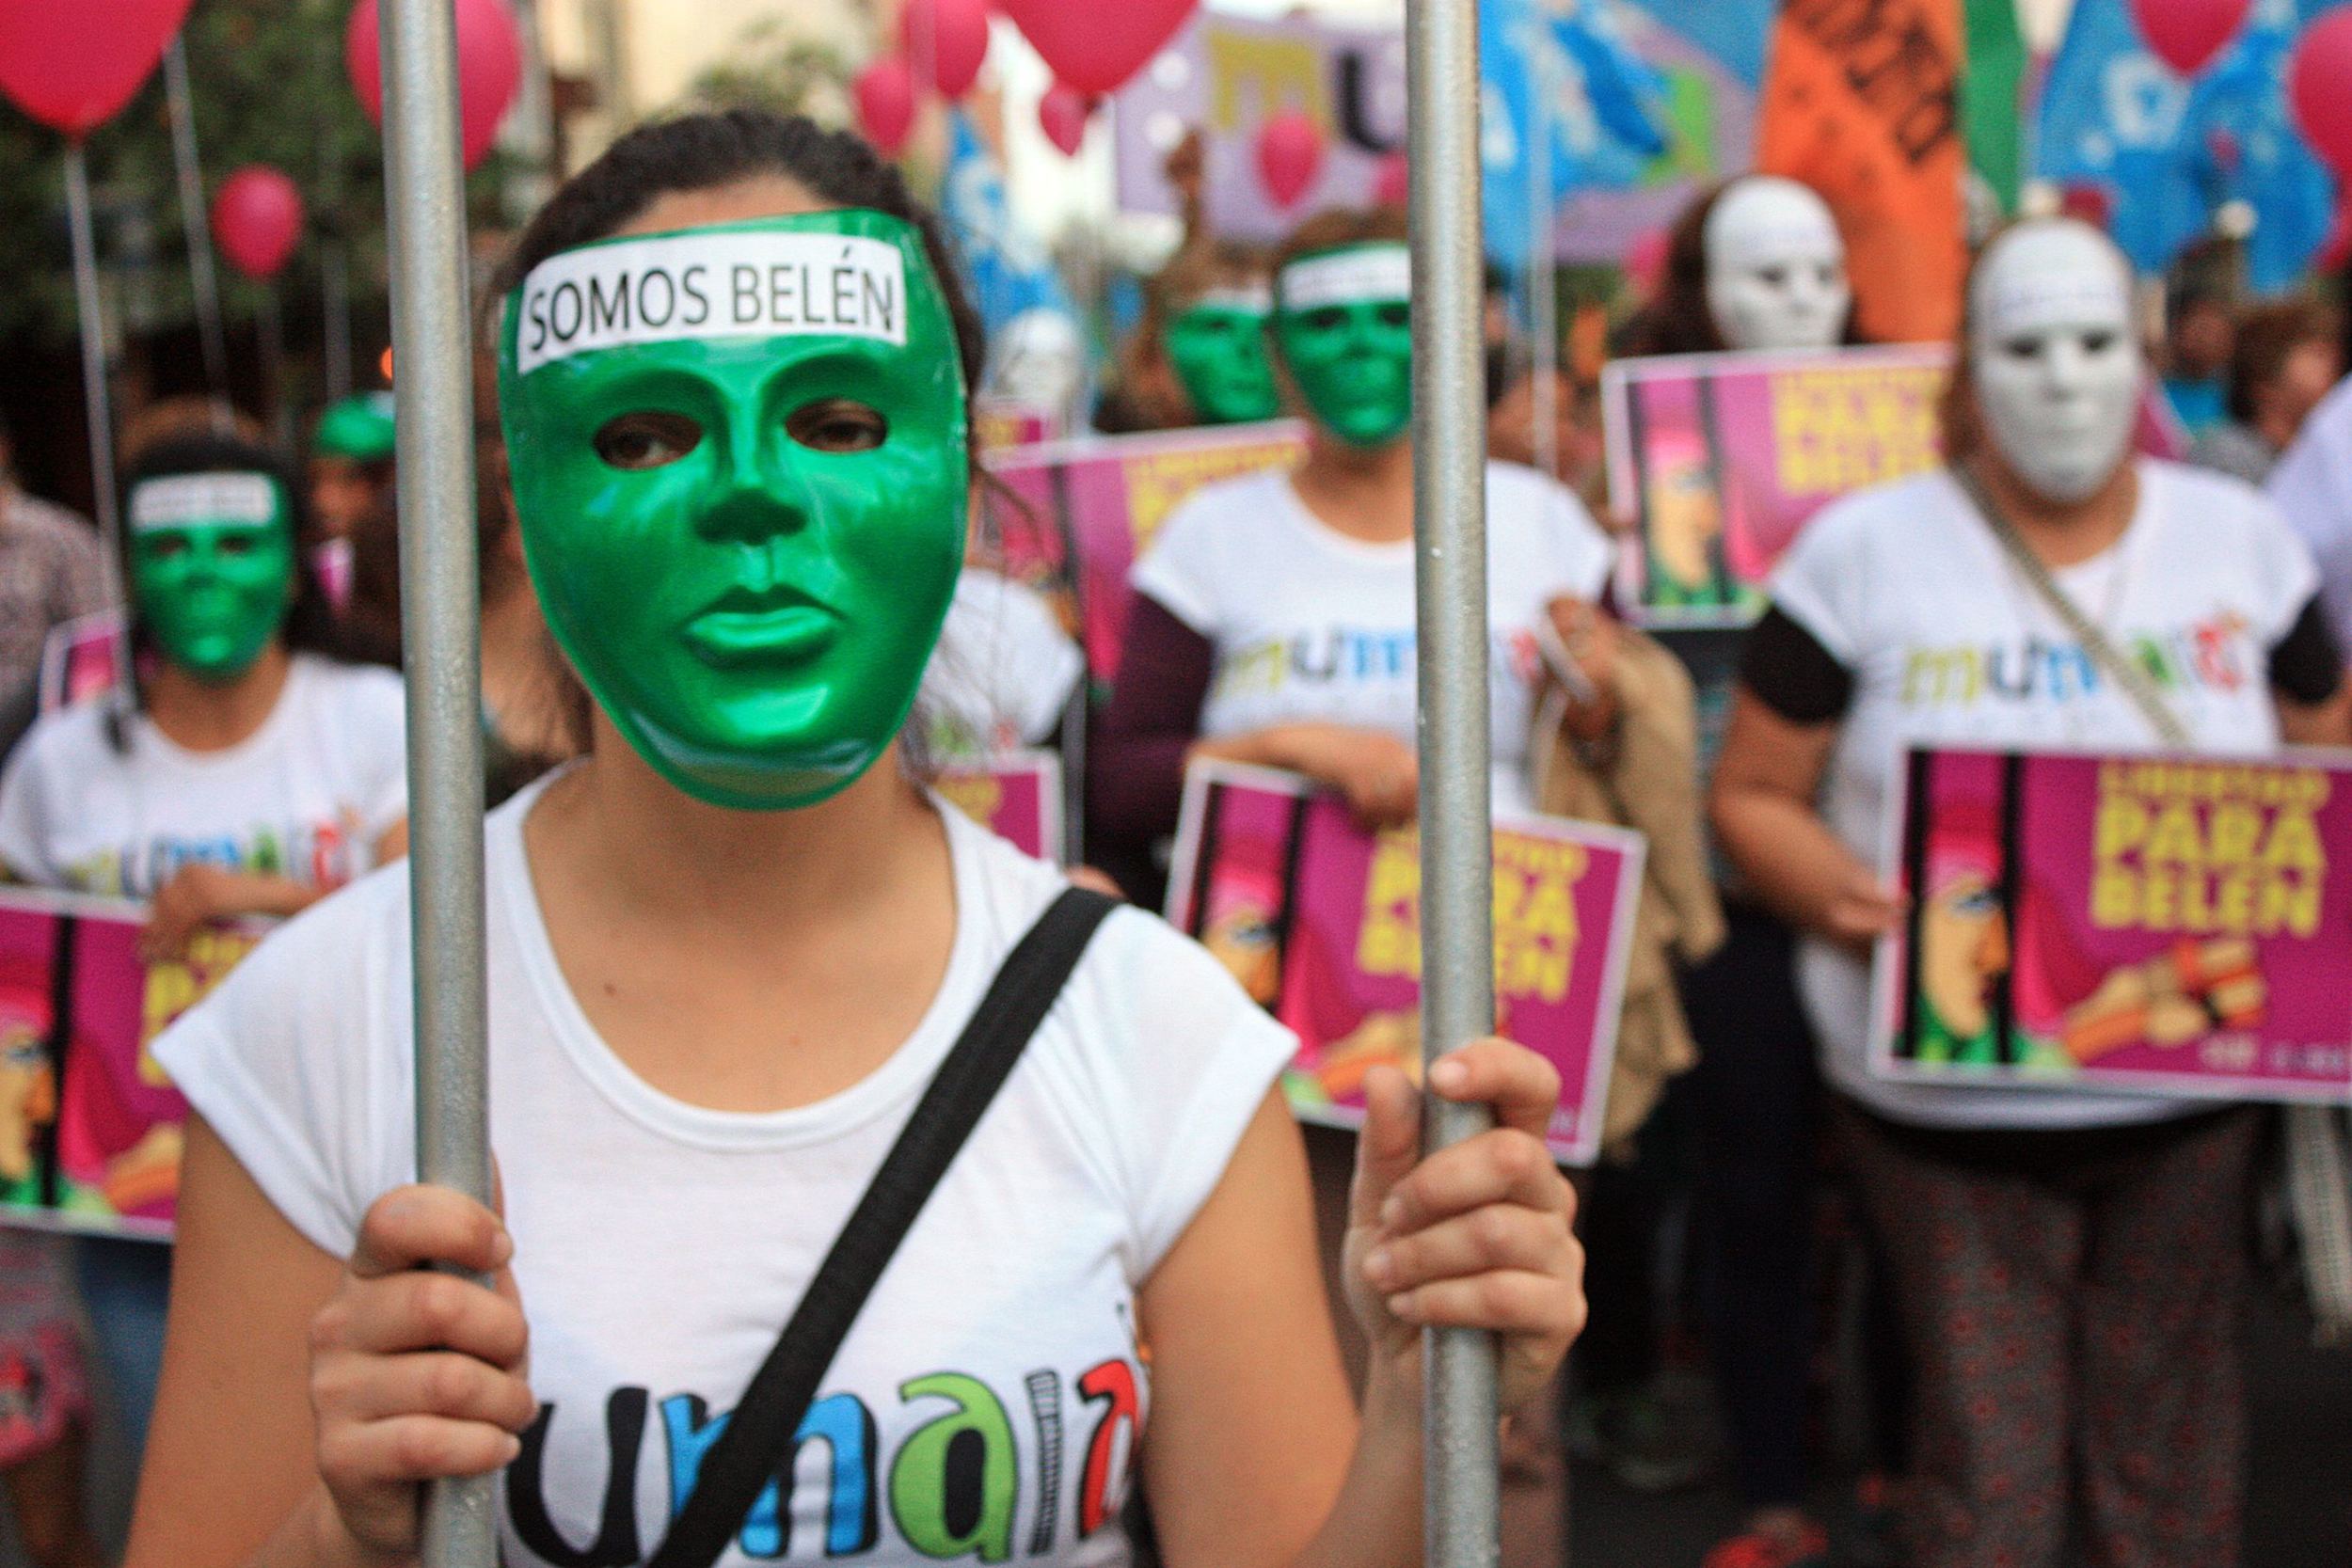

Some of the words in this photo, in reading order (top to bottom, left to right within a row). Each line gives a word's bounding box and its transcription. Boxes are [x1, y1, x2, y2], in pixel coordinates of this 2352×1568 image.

[529, 264, 709, 352] SOMOS
[731, 245, 894, 331] BELÉN
[2096, 800, 2324, 867] PARA
